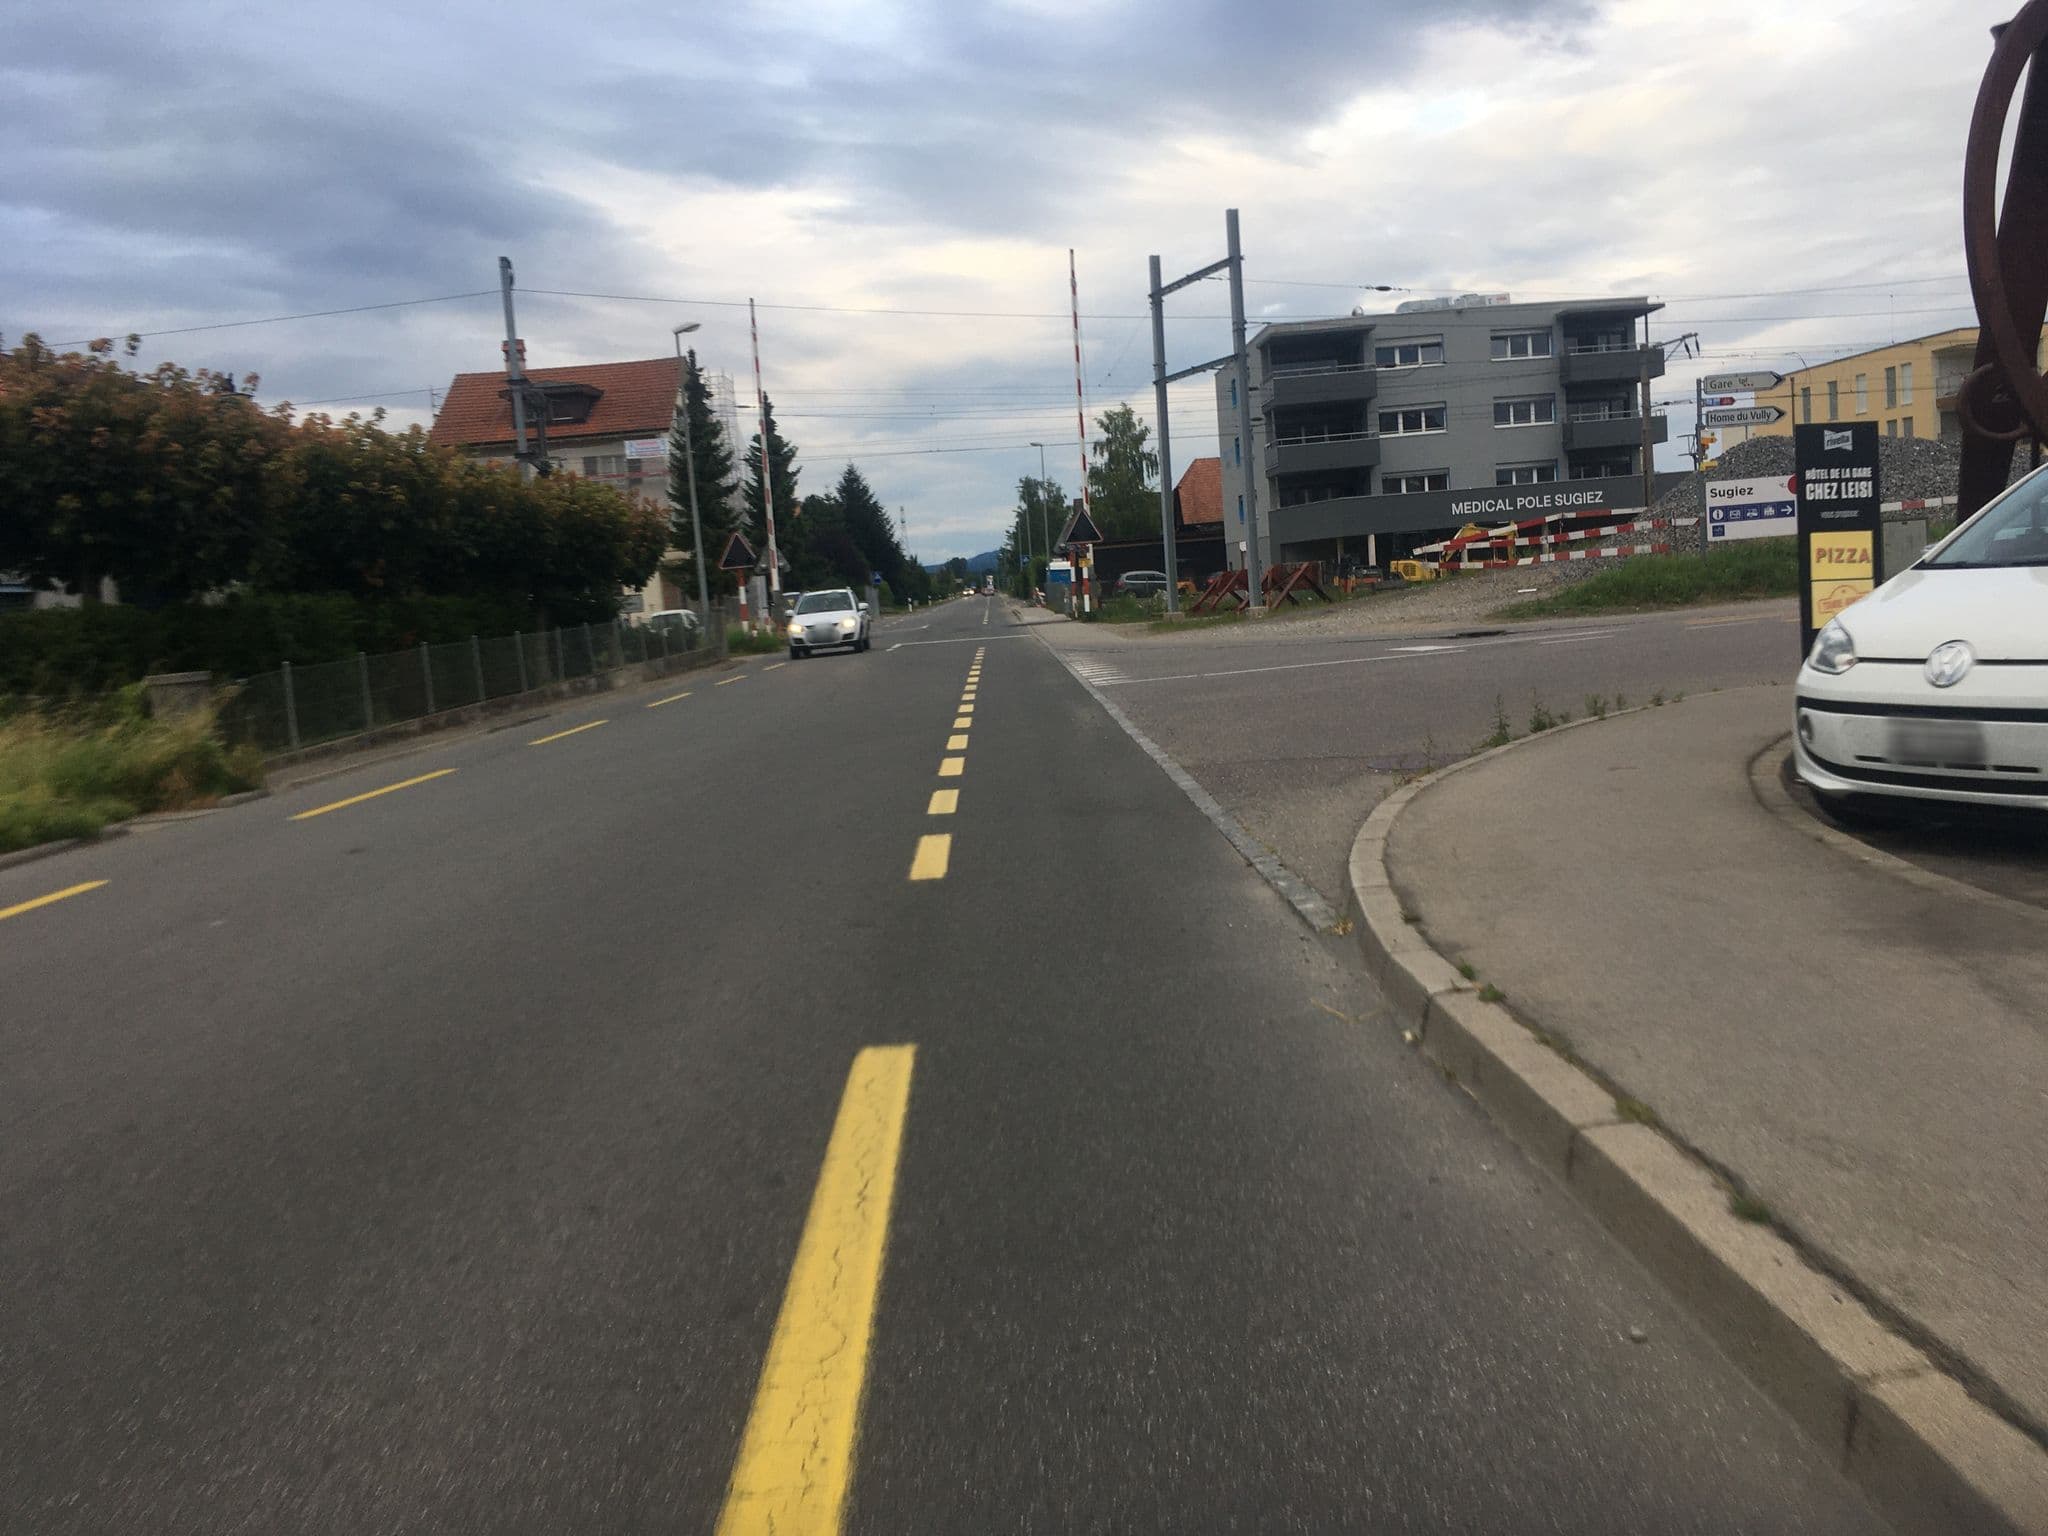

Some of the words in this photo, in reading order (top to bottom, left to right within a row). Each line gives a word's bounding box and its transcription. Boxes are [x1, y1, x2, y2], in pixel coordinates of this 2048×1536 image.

[1709, 379, 1733, 390] Gare
[1710, 413, 1735, 423] Home
[1737, 410, 1748, 421] du
[1750, 409, 1772, 421] Vully
[1805, 467, 1829, 480] HÔTEL
[1829, 468, 1840, 479] DE
[1841, 467, 1851, 479] LA
[1852, 467, 1873, 478] GARE
[1710, 486, 1754, 499] Sugiez
[1805, 482, 1838, 500] CHEZ
[1841, 481, 1873, 499] LEISI
[1451, 498, 1513, 515] MEDICAL
[1516, 495, 1552, 509] POLE
[1554, 491, 1604, 506] SUGIEZ
[1815, 547, 1872, 564] PIZZA
